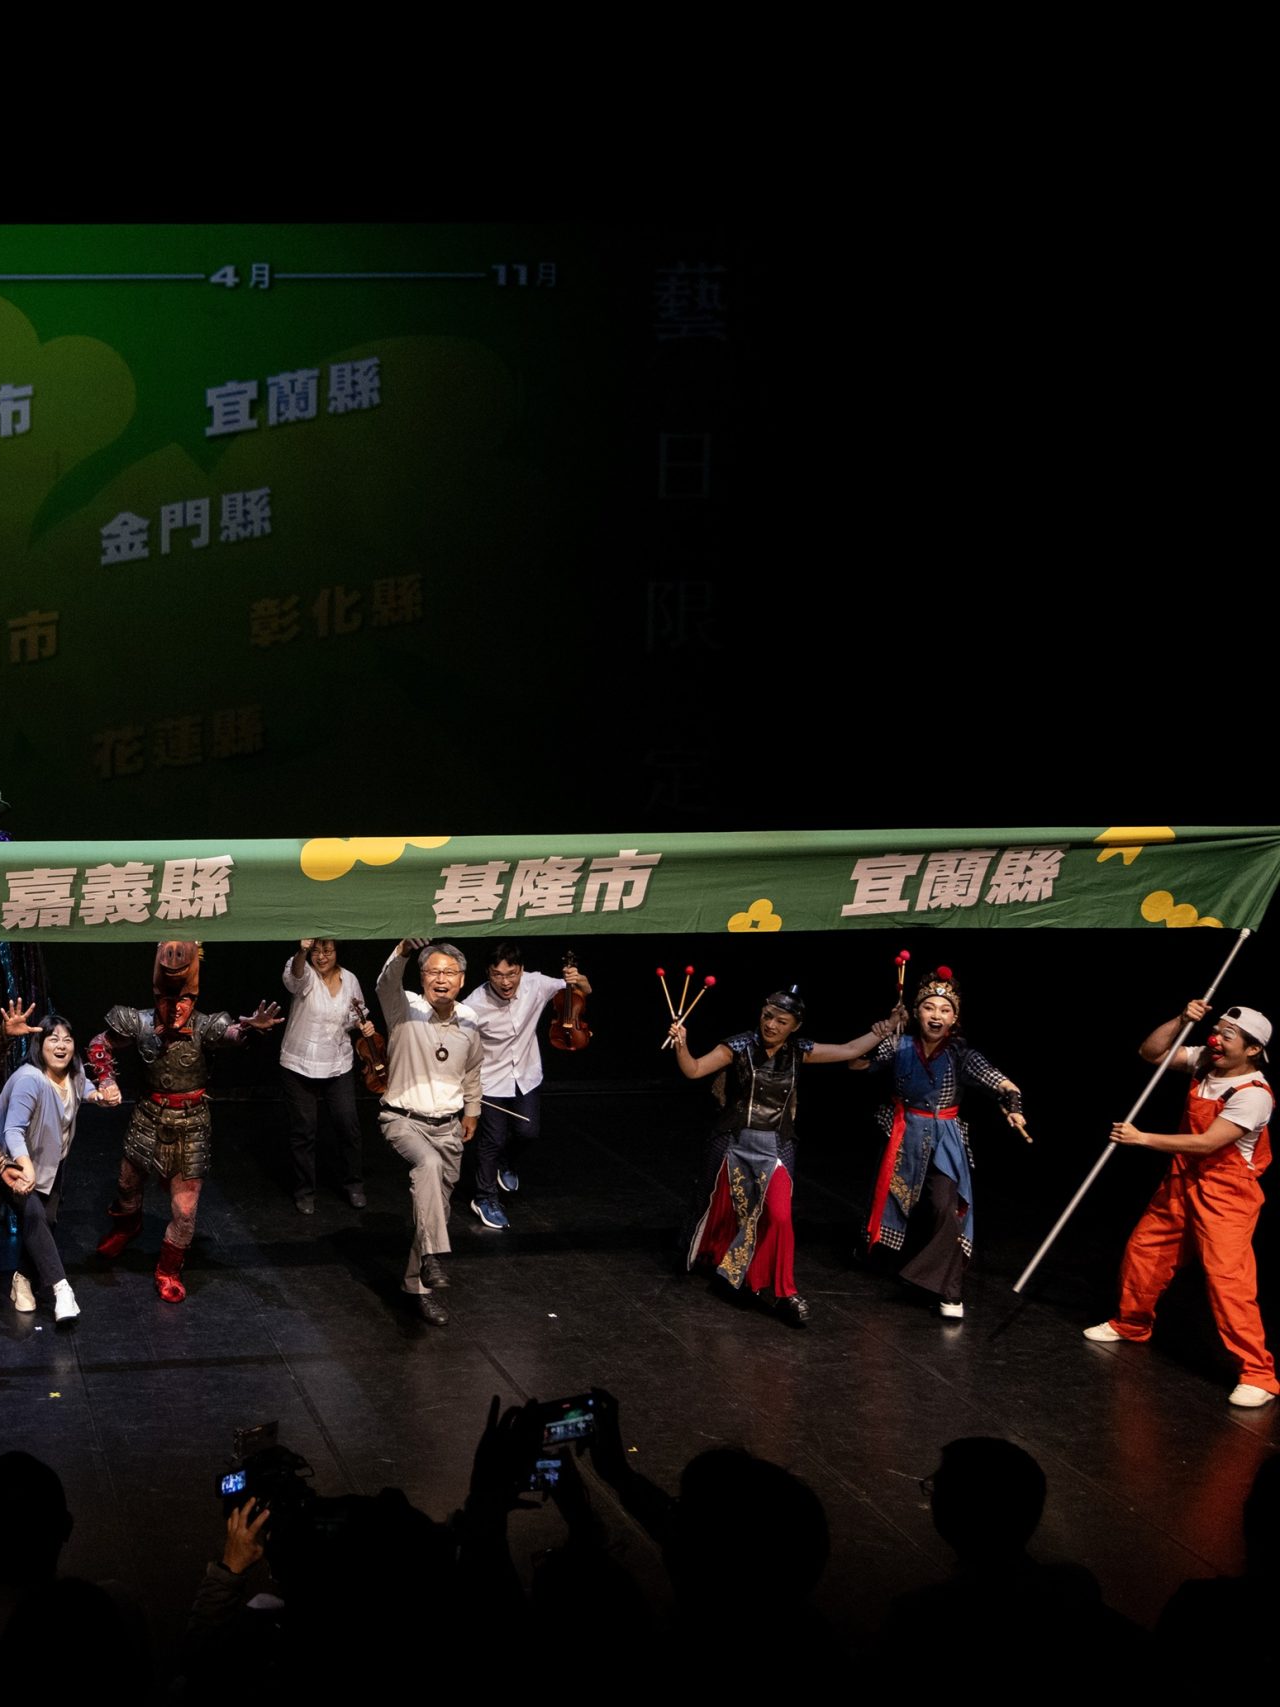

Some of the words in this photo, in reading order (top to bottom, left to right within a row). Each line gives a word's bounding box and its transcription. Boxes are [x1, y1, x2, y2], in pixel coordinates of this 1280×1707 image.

[490, 261, 558, 289] 11月
[203, 356, 382, 438] 宜蘭縣
[99, 485, 274, 567] 金門縣
[246, 571, 424, 649] 彰化縣
[91, 704, 267, 782] 花蓮縣
[0, 854, 236, 931] 嘉義縣
[431, 848, 664, 926] 基隆市
[840, 844, 1072, 918] 宜蘭縣
